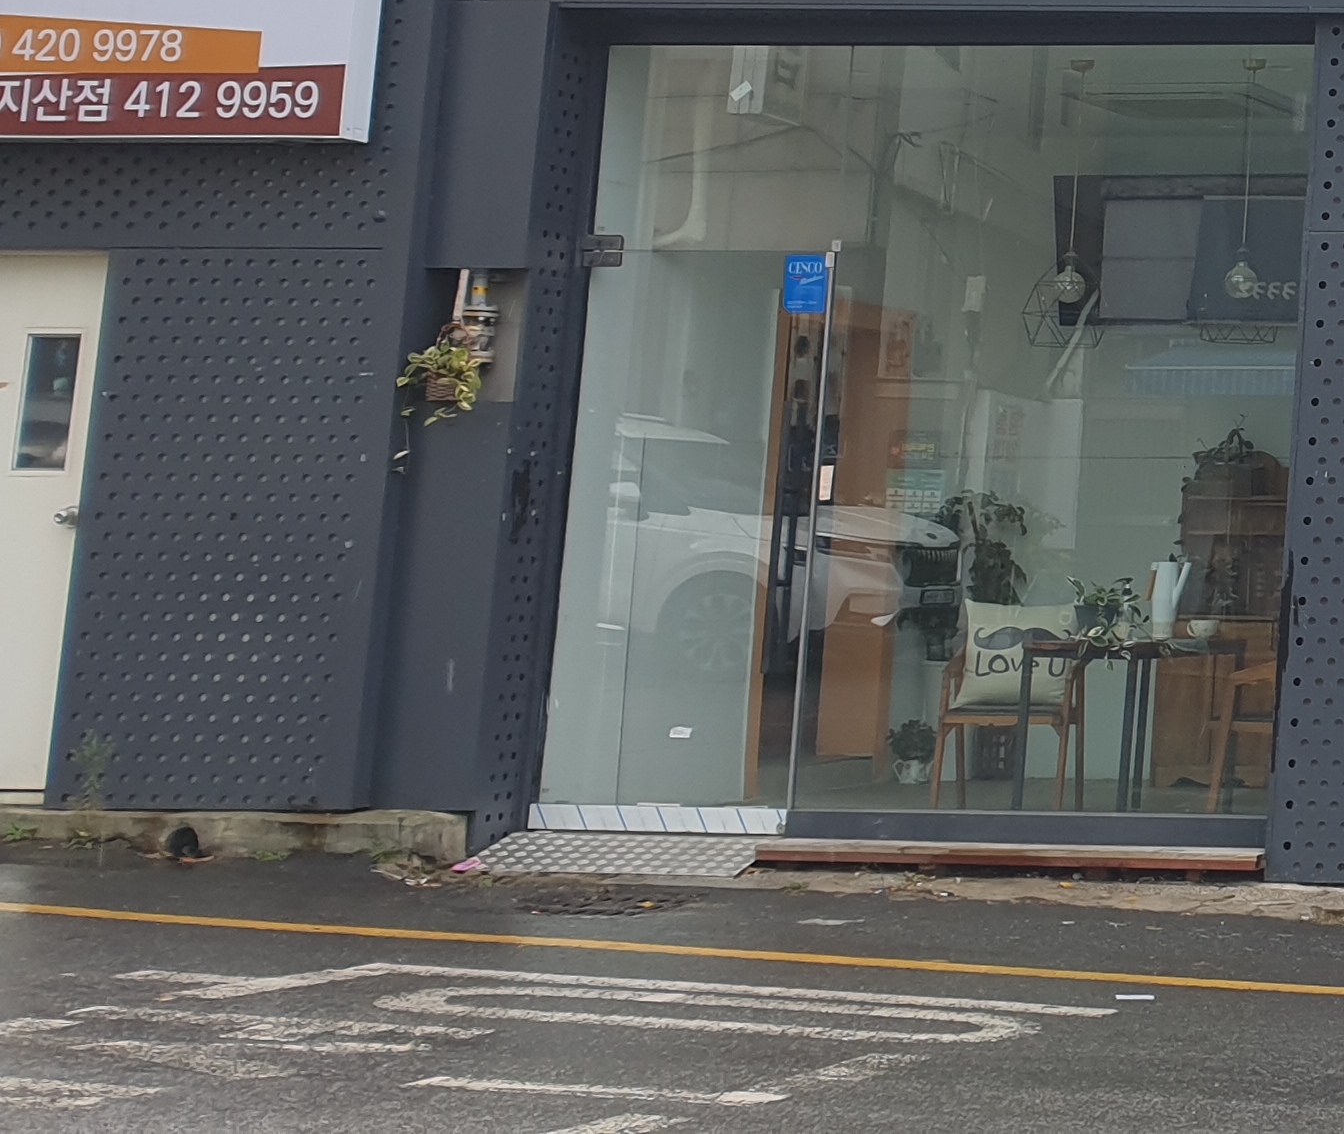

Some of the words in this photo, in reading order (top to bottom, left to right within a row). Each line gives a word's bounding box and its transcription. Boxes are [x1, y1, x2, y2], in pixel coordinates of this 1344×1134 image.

[12, 28, 80, 62] 420
[93, 29, 183, 63] 9978
[0, 78, 110, 123] 지산점
[124, 82, 201, 119] 412
[216, 81, 320, 119] 9959
